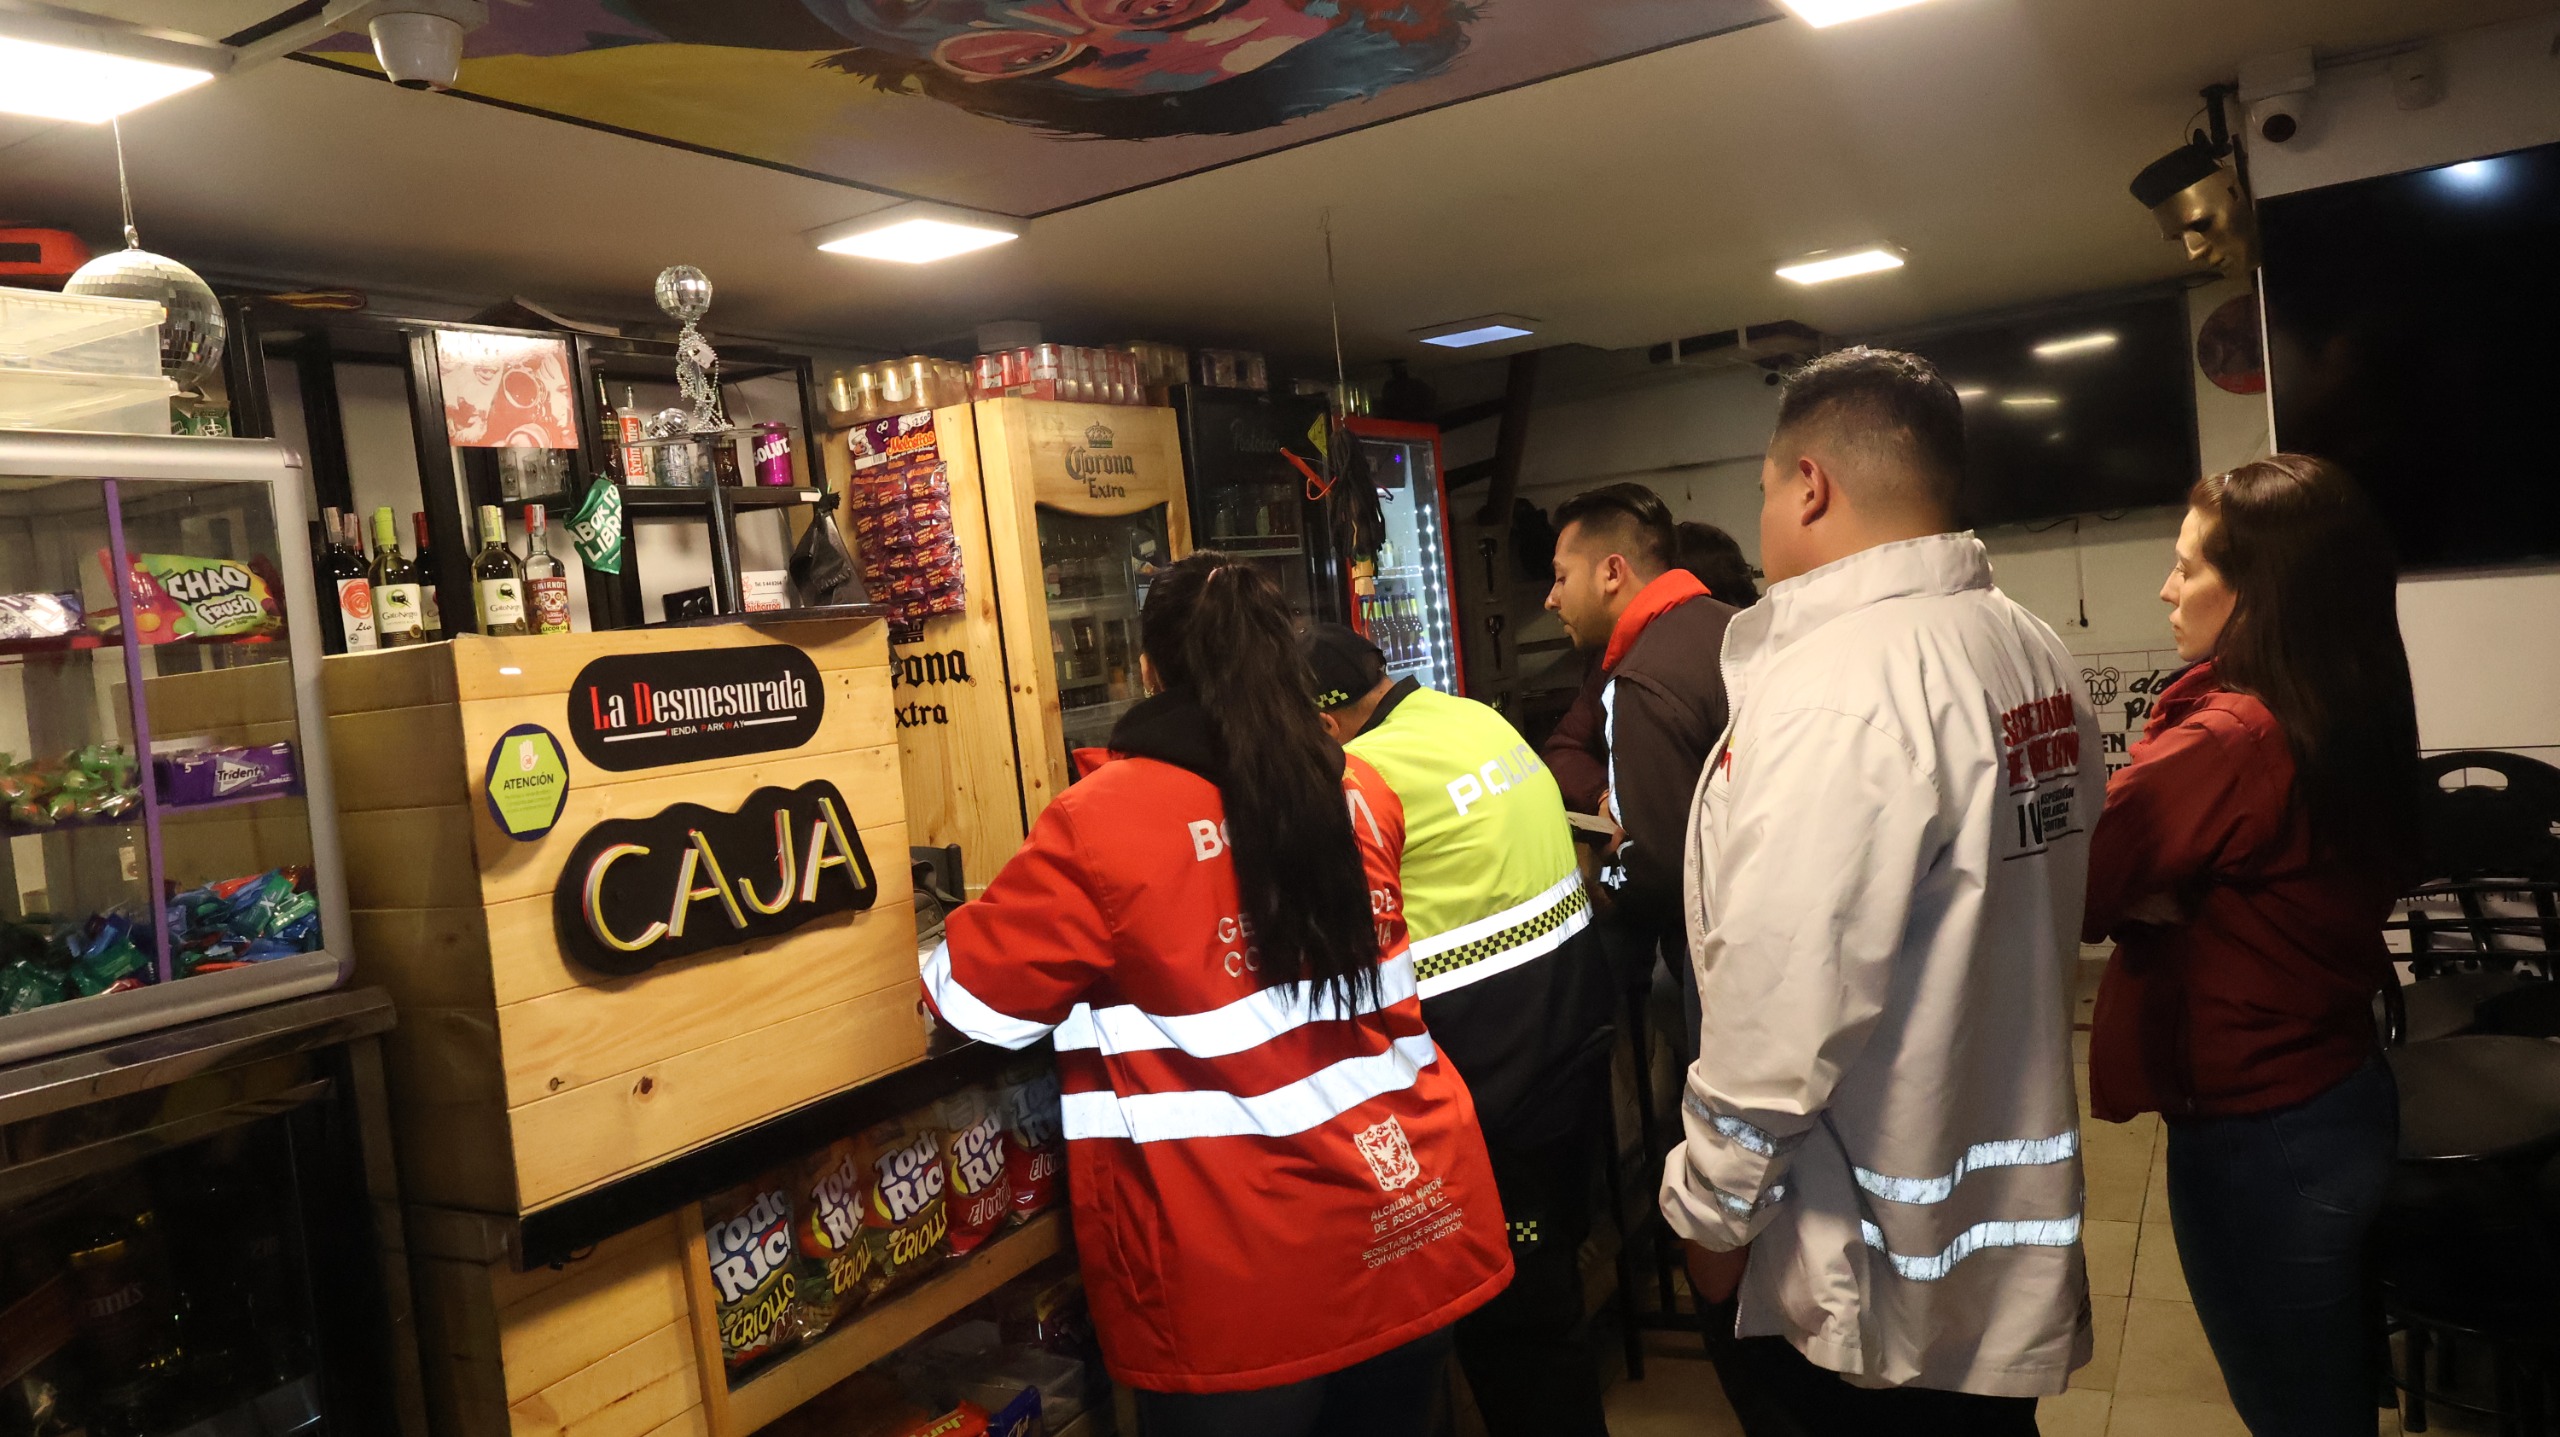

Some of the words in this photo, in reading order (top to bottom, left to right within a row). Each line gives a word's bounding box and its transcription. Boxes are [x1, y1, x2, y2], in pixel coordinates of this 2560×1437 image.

[627, 421, 642, 475] Schnider
[1065, 446, 1135, 484] Corona
[1088, 478, 1126, 498] Extra
[166, 565, 251, 603] CHAO
[589, 685, 627, 731] La
[633, 670, 808, 726] Desmesurada
[894, 701, 949, 729] xtra
[666, 725, 698, 737] TIENDA
[701, 719, 745, 733] PARKWAY
[217, 766, 260, 781] Trident
[503, 772, 554, 791] ATENCIÓN
[1445, 743, 1546, 817] POLIC
[583, 797, 866, 951] CAJA
[885, 1160, 945, 1221] Ric
[1416, 1177, 1443, 1200] MAYOR
[824, 1190, 865, 1249] Ric
[1374, 1220, 1388, 1234] DE
[1413, 1227, 1424, 1239] DE
[1368, 1241, 1424, 1269] CONVIVENCIA
[1431, 1221, 1464, 1242] JUSTICIA
[833, 1237, 872, 1295] CRIOLL
[730, 1272, 796, 1347] CRIOLLO
